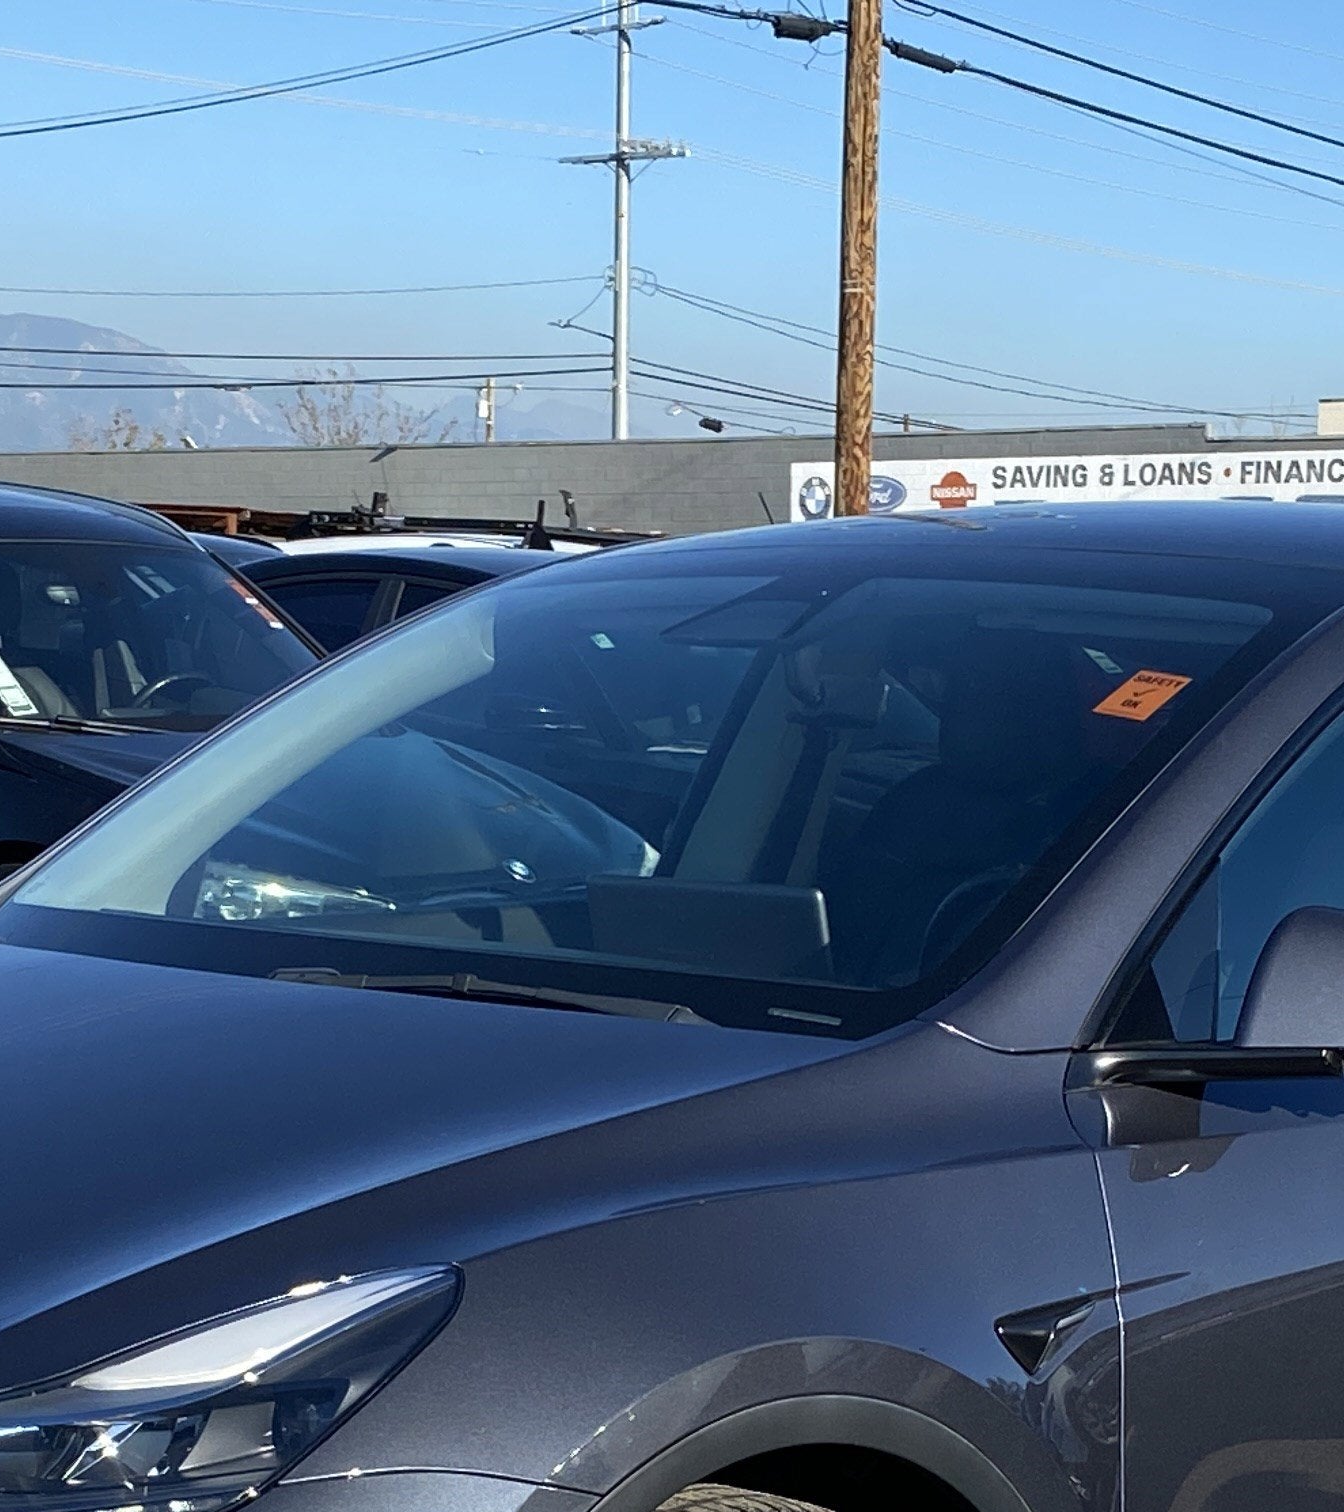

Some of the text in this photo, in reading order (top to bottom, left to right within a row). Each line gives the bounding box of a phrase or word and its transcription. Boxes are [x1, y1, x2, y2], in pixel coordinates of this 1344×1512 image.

[991, 464, 1088, 489] SAVING
[1099, 463, 1114, 486] &
[1122, 461, 1212, 486] LOANS
[933, 487, 974, 498] NISSAN
